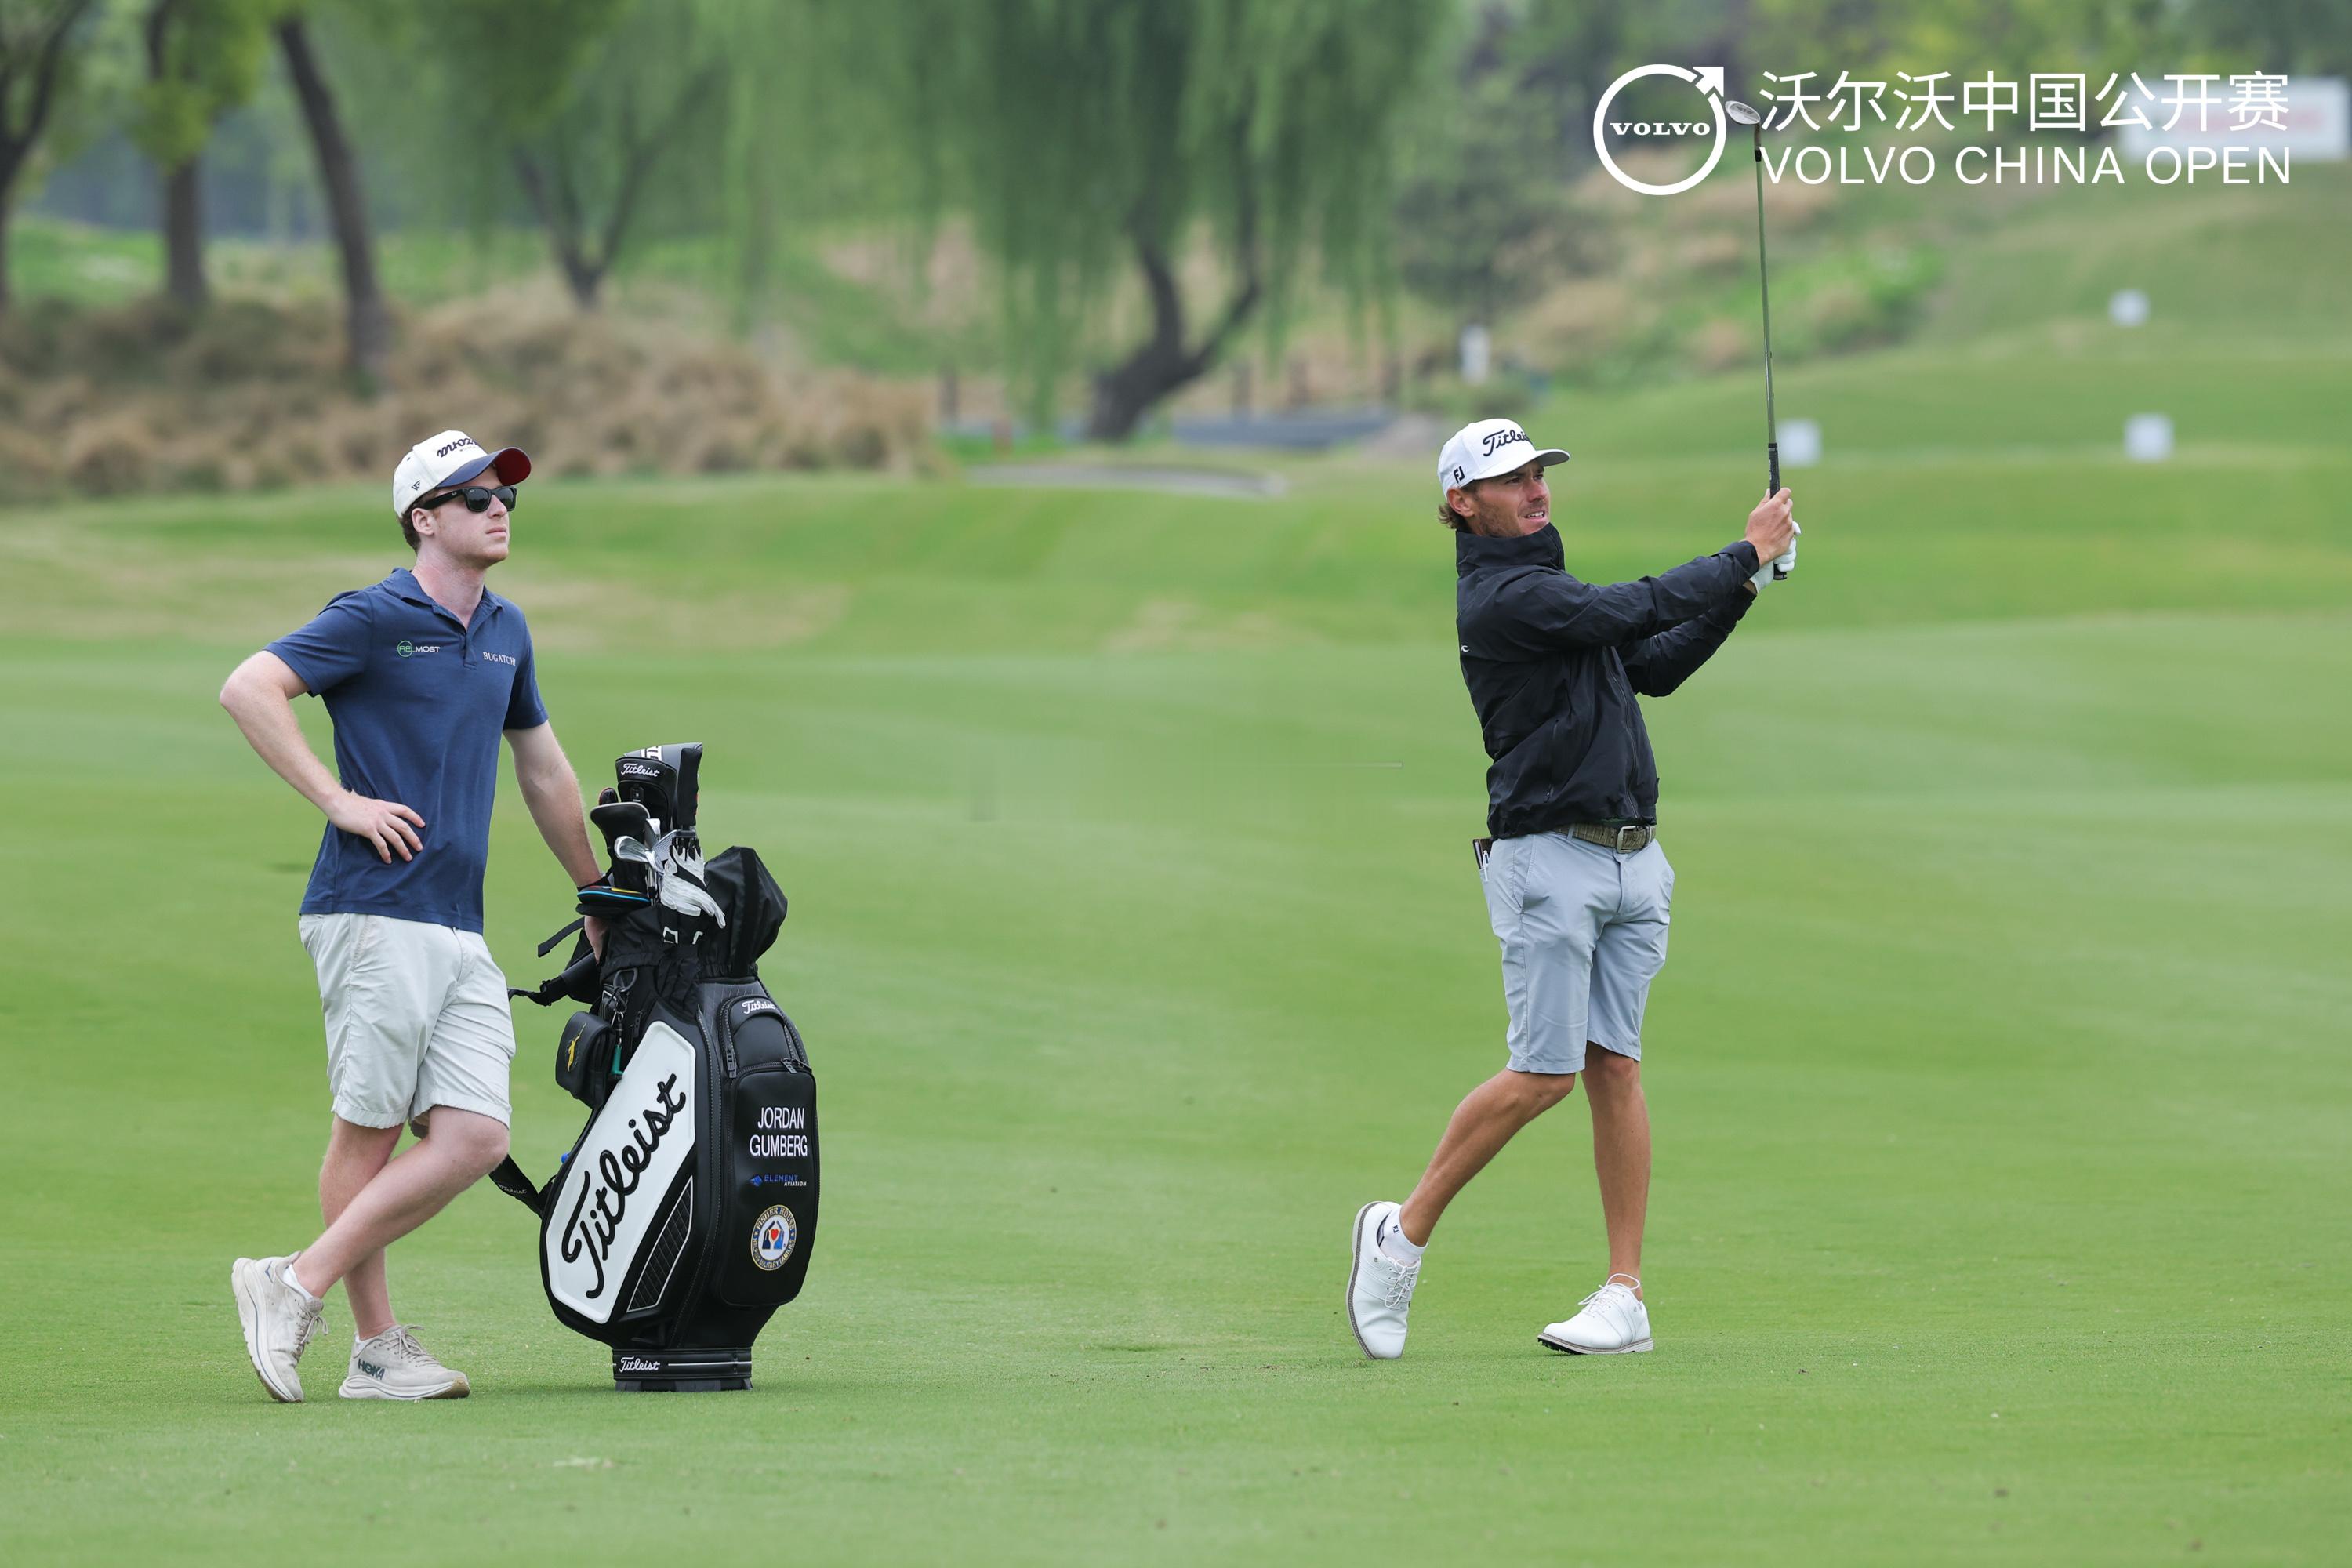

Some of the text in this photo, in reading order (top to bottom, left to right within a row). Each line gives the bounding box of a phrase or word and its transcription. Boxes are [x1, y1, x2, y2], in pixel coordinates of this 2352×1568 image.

[1483, 429, 1531, 456] Titlei
[482, 652, 516, 666] BUGATCHI
[620, 762, 660, 777] Titleist
[757, 1106, 804, 1129] JORDAN
[749, 1134, 808, 1157] GUMBERG
[561, 1073, 687, 1299] Titleist
[358, 1358, 385, 1380] HOKA
[619, 1356, 661, 1373] Titleist
